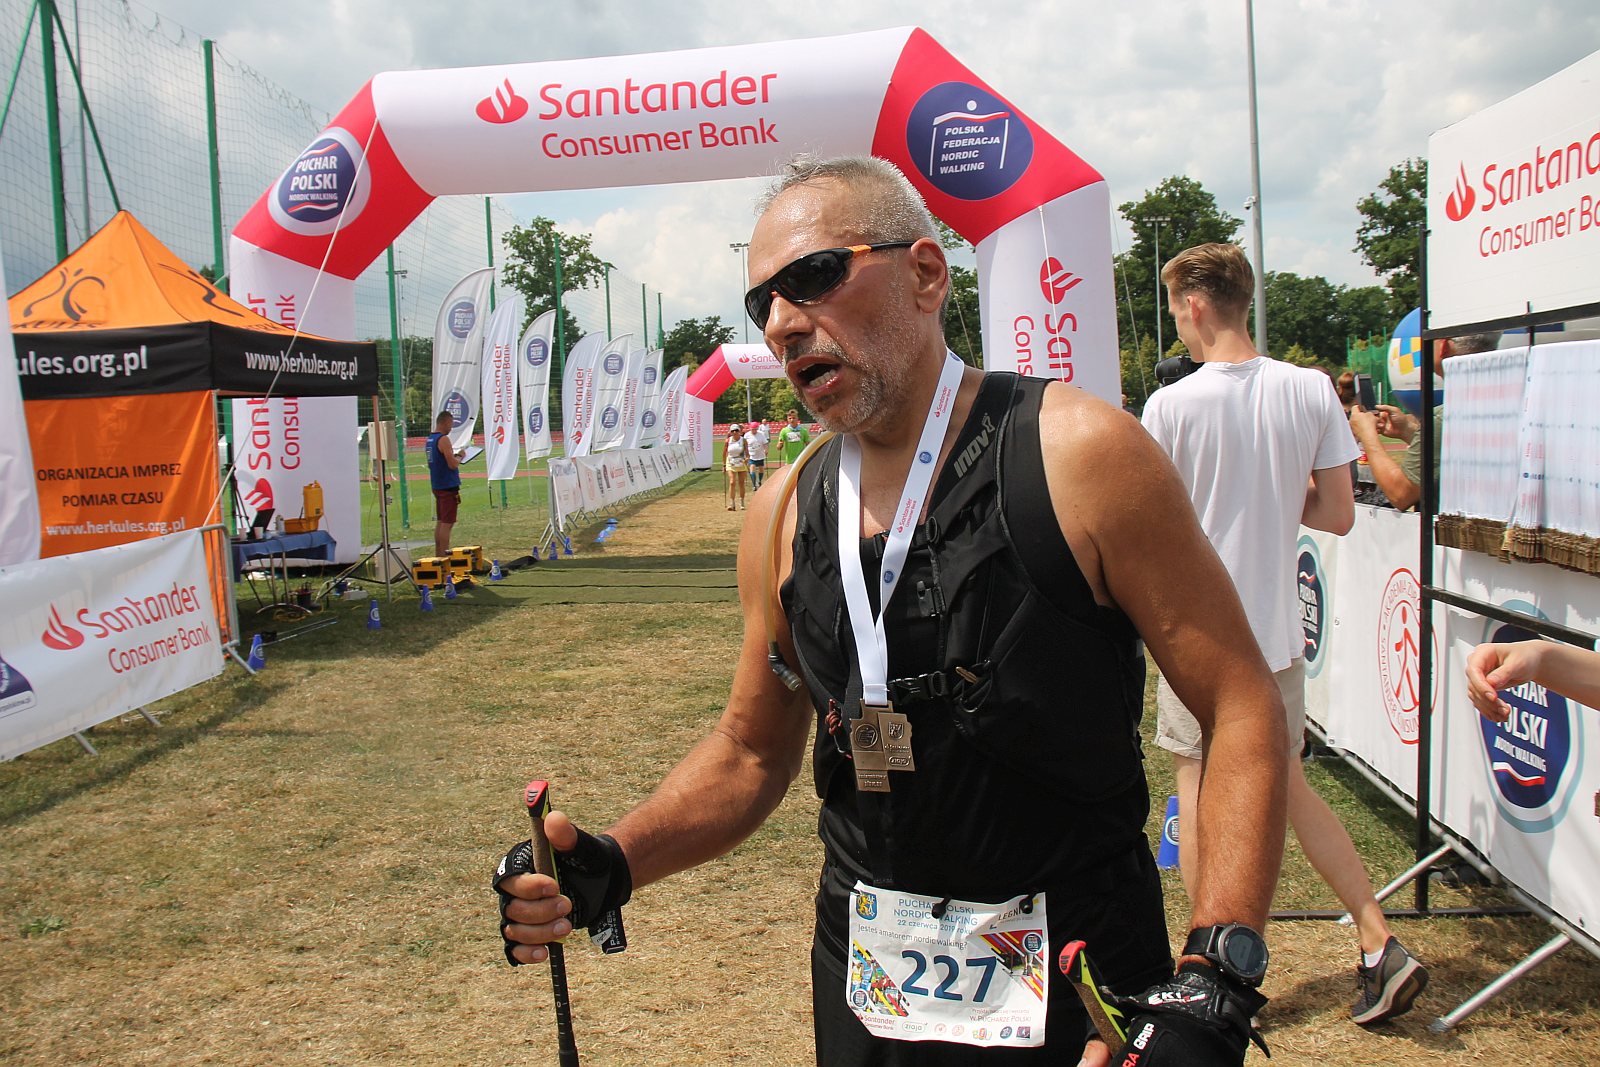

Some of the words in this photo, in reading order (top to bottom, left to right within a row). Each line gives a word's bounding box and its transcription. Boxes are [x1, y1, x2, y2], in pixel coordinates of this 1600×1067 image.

[538, 70, 777, 120] Santander
[541, 129, 693, 159] Consumer
[698, 118, 779, 148] Bank
[943, 136, 1001, 149] FEDERACJA
[945, 125, 985, 136] POLSKA
[295, 155, 338, 173] PUCHAR
[939, 162, 985, 175] WALKING
[941, 150, 979, 162] NORDIC
[1481, 124, 1600, 212] Santand
[288, 193, 310, 201] NORDIC
[310, 192, 338, 201] WALKING
[290, 173, 338, 192] POLSKI
[1480, 207, 1576, 257] Consumer
[275, 294, 296, 331] ank
[1014, 315, 1035, 376] Cons
[18, 346, 147, 378] ules.org.pl
[245, 350, 358, 380] www.herkules.org.pl
[493, 343, 504, 424] Santander
[574, 367, 584, 429] Santander
[663, 389, 674, 432] Santander
[937, 385, 948, 412] Santander
[280, 397, 300, 470] Consu
[37, 466, 129, 482] ORGANIZACJA
[132, 463, 182, 478] IMPREZ
[62, 493, 118, 507] POMIAR
[121, 491, 164, 505] CZASU
[900, 498, 912, 526] Santander
[46, 517, 186, 536] www.herkules.org.pl
[76, 581, 201, 639] Santander
[108, 635, 180, 674] Consumer
[177, 620, 212, 651] Bank
[1505, 680, 1549, 708] CHAR
[1497, 703, 1549, 750] OLSKI
[893, 909, 932, 920] NORDIC
[946, 904, 975, 914] OLSKI
[999, 906, 1022, 921] LEGNI
[879, 929, 913, 941] amatorem
[914, 934, 936, 945] nordic
[936, 938, 968, 951] walking?
[908, 921, 938, 931] czerwca
[940, 923, 956, 932] 2019
[956, 925, 973, 935] roku
[901, 949, 998, 1003] 227
[865, 1015, 896, 1025] Santander
[1133, 1022, 1155, 1051] GRIP
